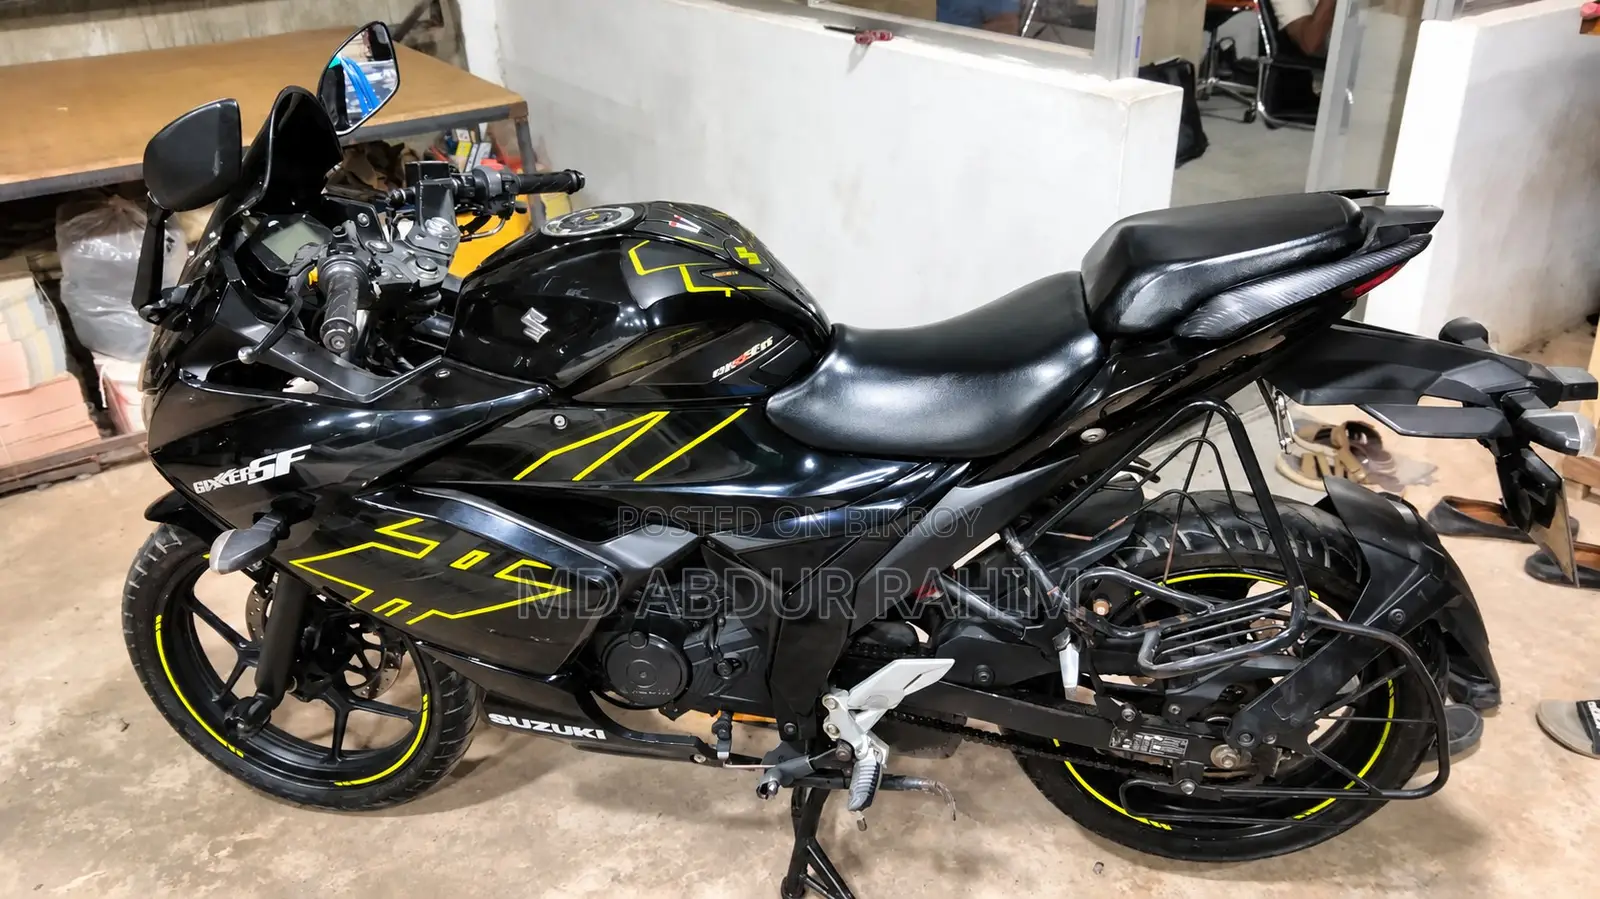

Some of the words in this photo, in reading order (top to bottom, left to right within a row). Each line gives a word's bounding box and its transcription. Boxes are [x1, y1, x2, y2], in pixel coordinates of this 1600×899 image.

[192, 467, 257, 494] GIXXER
[247, 444, 312, 485] SF
[488, 713, 607, 740] SUZUKI
